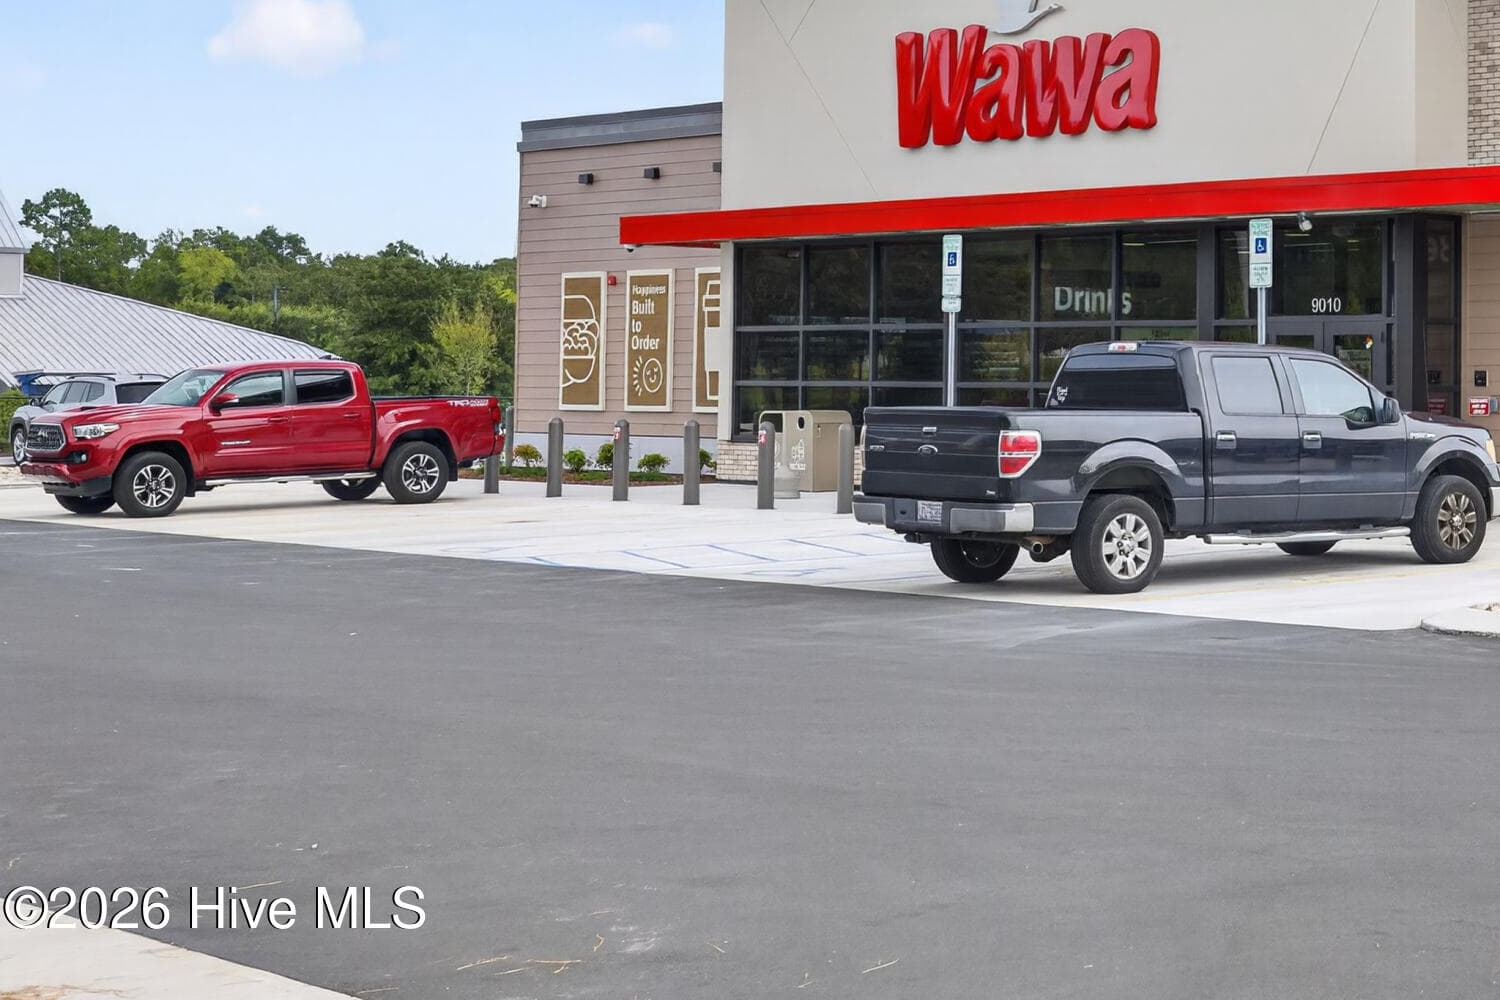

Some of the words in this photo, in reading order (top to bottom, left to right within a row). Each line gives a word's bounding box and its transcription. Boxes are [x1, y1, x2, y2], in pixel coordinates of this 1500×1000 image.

[895, 24, 1161, 149] Wawa
[632, 299, 655, 315] Built
[1311, 297, 1342, 313] 9010
[632, 318, 642, 333] to
[631, 334, 660, 350] Order
